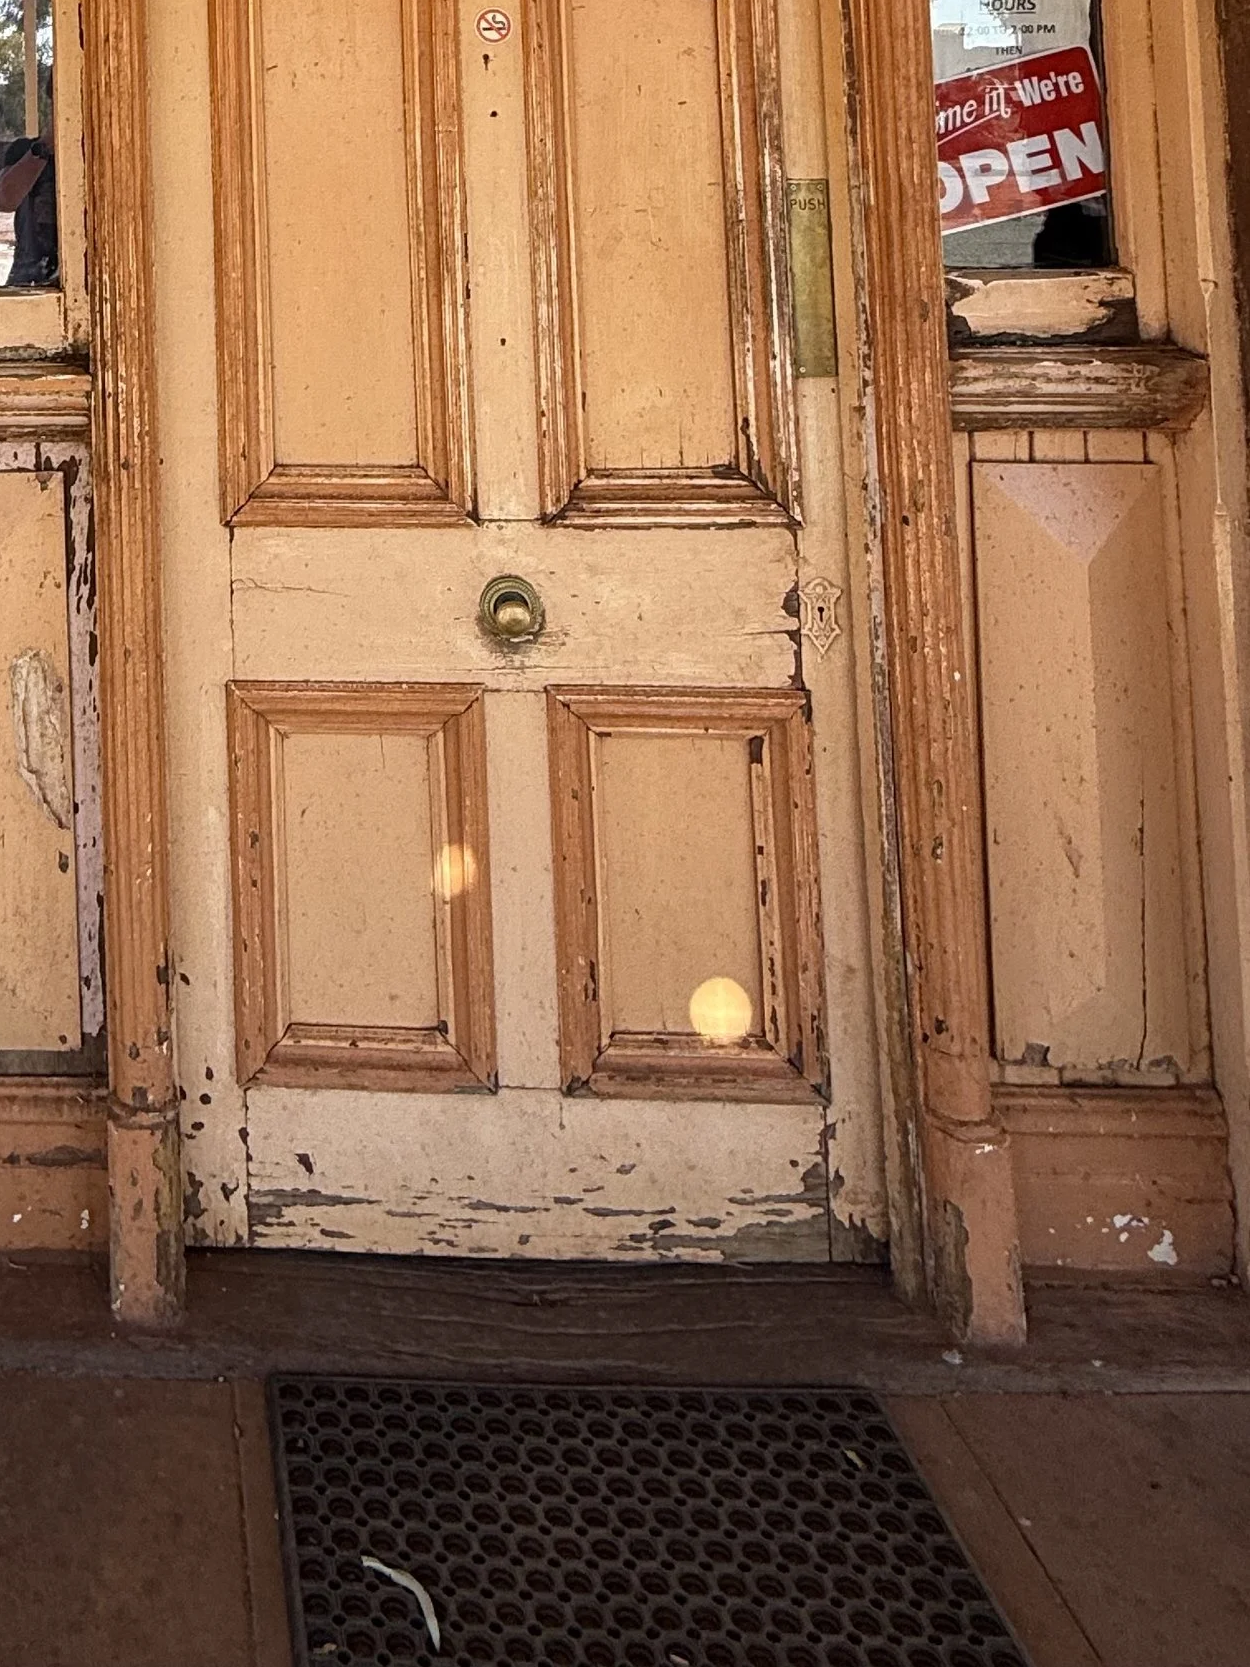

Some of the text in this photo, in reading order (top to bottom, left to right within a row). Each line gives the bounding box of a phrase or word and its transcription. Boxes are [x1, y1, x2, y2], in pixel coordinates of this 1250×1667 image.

[1037, 24, 1056, 34] PM
[1014, 70, 1085, 107] We're
[790, 198, 826, 211] PUSH
